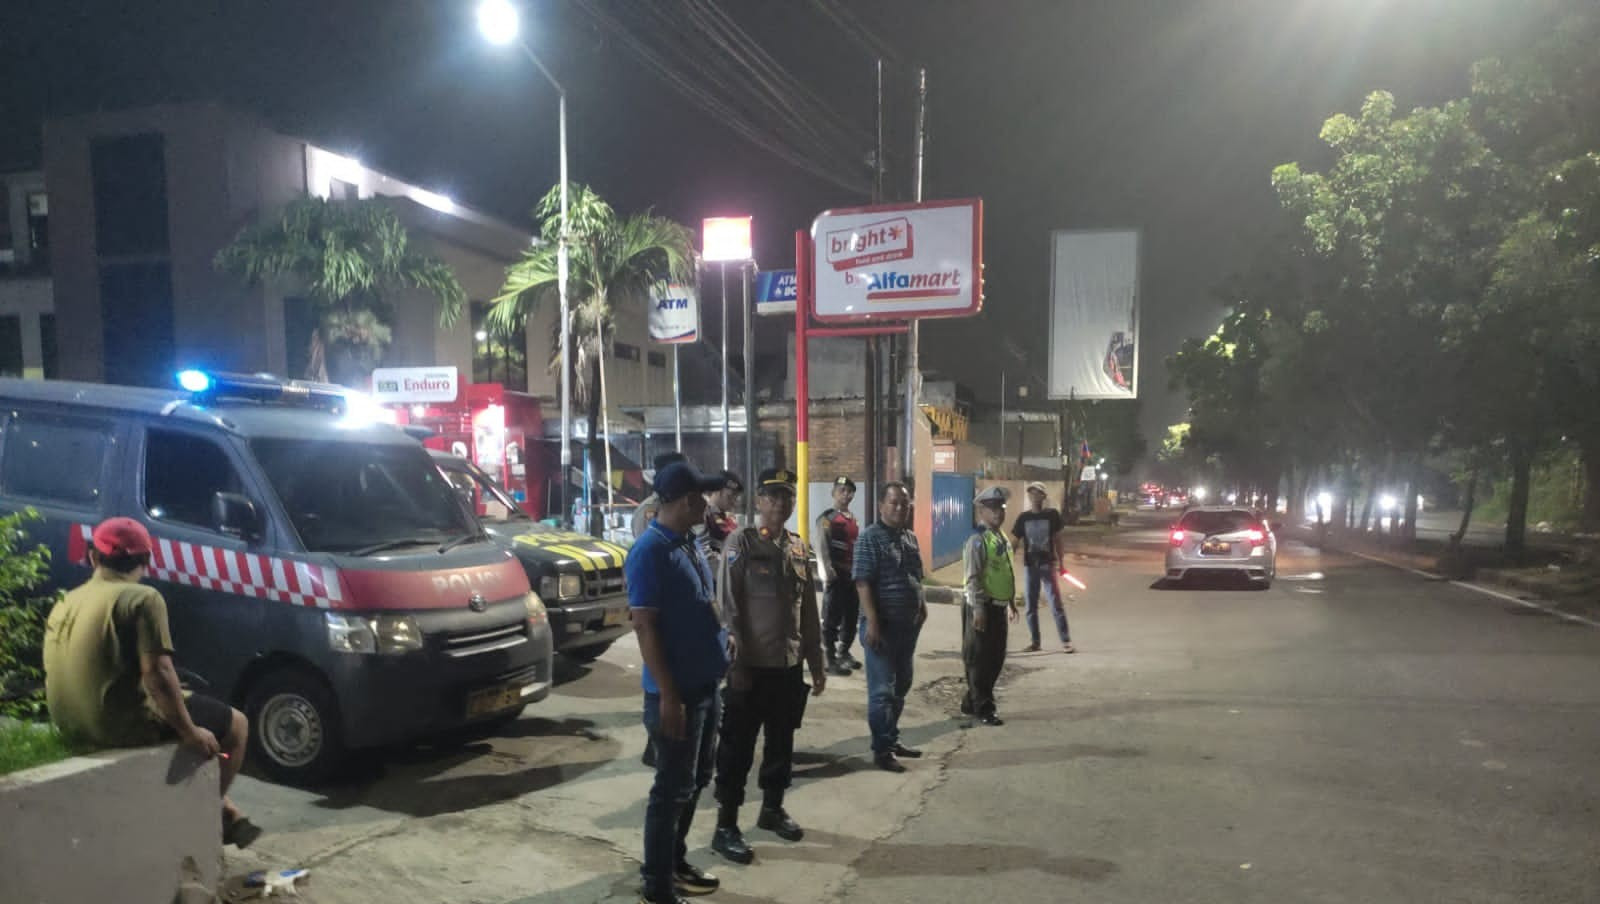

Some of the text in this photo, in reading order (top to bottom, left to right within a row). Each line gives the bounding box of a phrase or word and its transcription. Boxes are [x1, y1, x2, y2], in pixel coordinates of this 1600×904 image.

[831, 228, 886, 253] brght
[867, 269, 960, 290] Alfamart
[656, 298, 688, 310] ATM
[404, 377, 450, 392] Enduro
